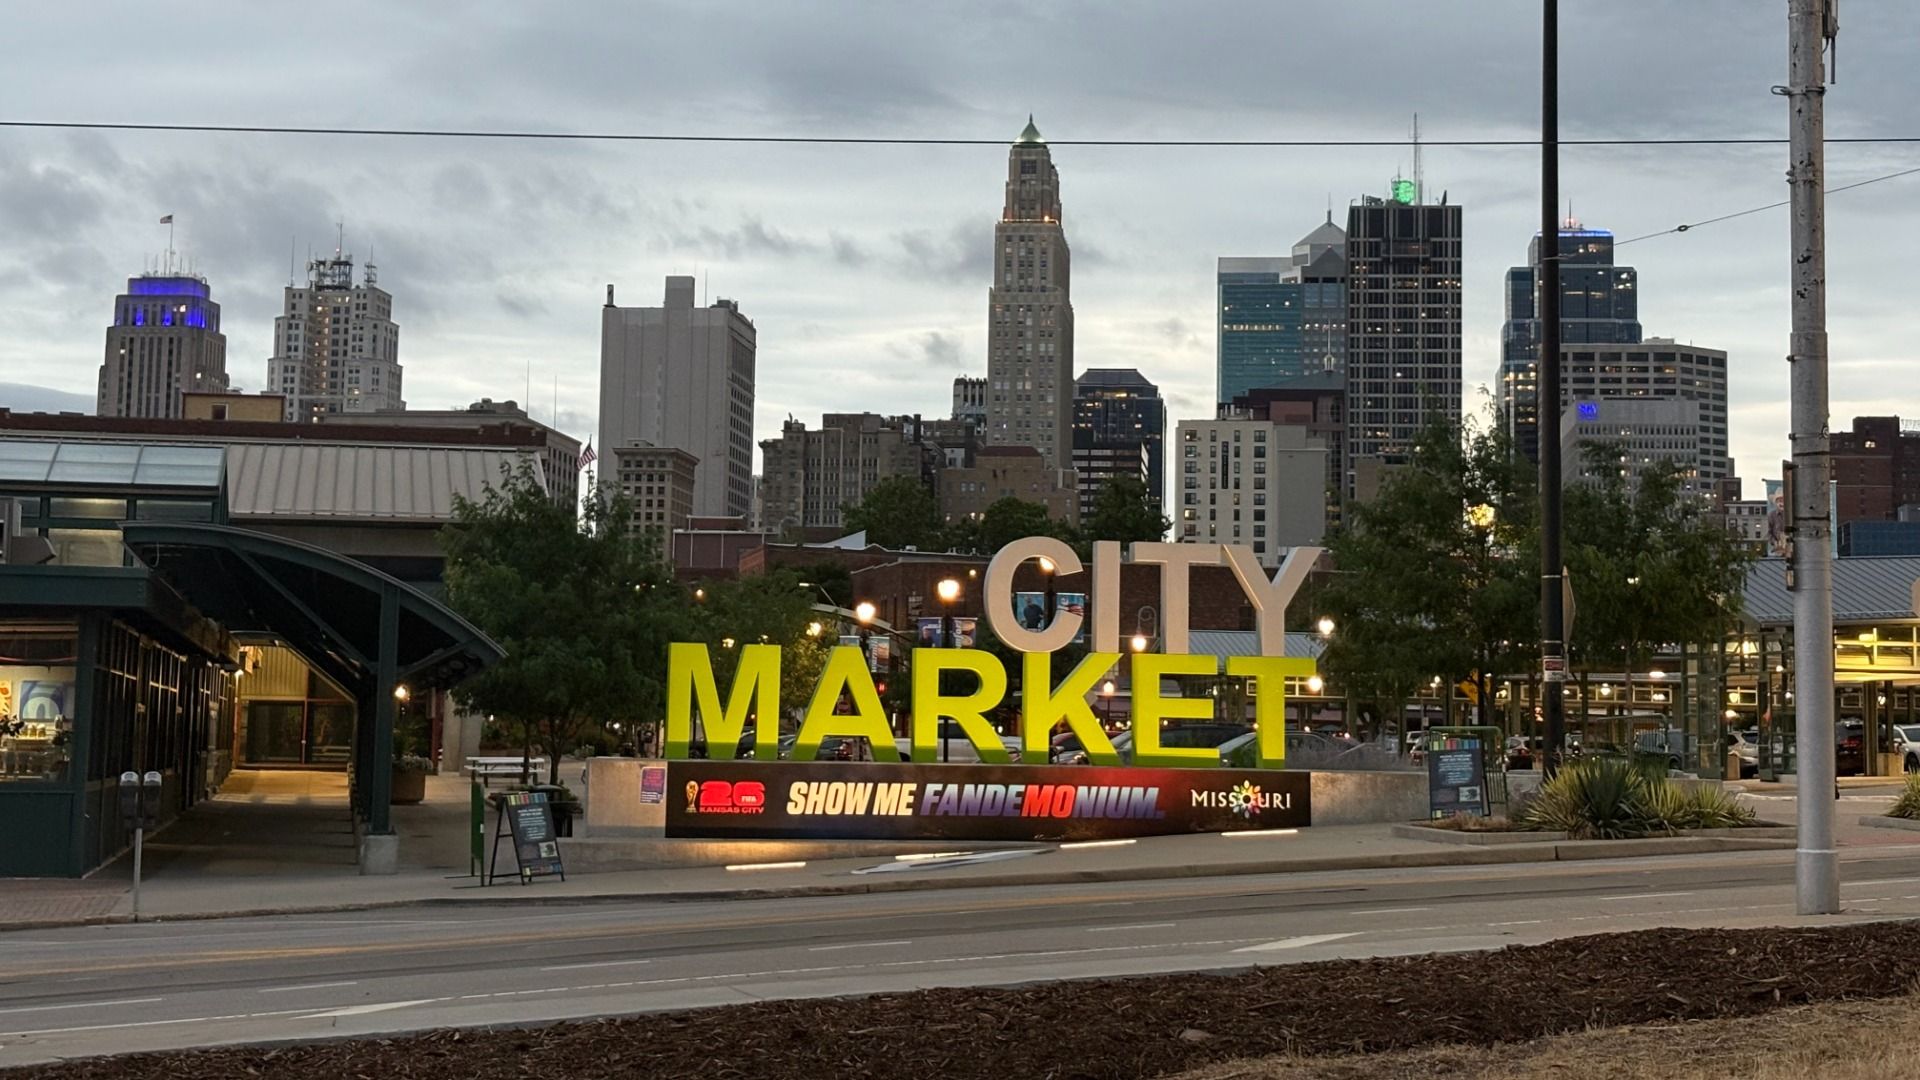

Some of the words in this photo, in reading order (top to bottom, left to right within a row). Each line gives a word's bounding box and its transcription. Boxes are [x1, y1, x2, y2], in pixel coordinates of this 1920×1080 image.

[984, 536, 1322, 656] CITY
[666, 643, 1316, 768] MARKET
[700, 806, 740, 814] KANSAS
[741, 806, 764, 814] CITY
[787, 782, 872, 815] SHOW
[872, 783, 916, 816] ME
[1191, 789, 1291, 810] MISSOURI
